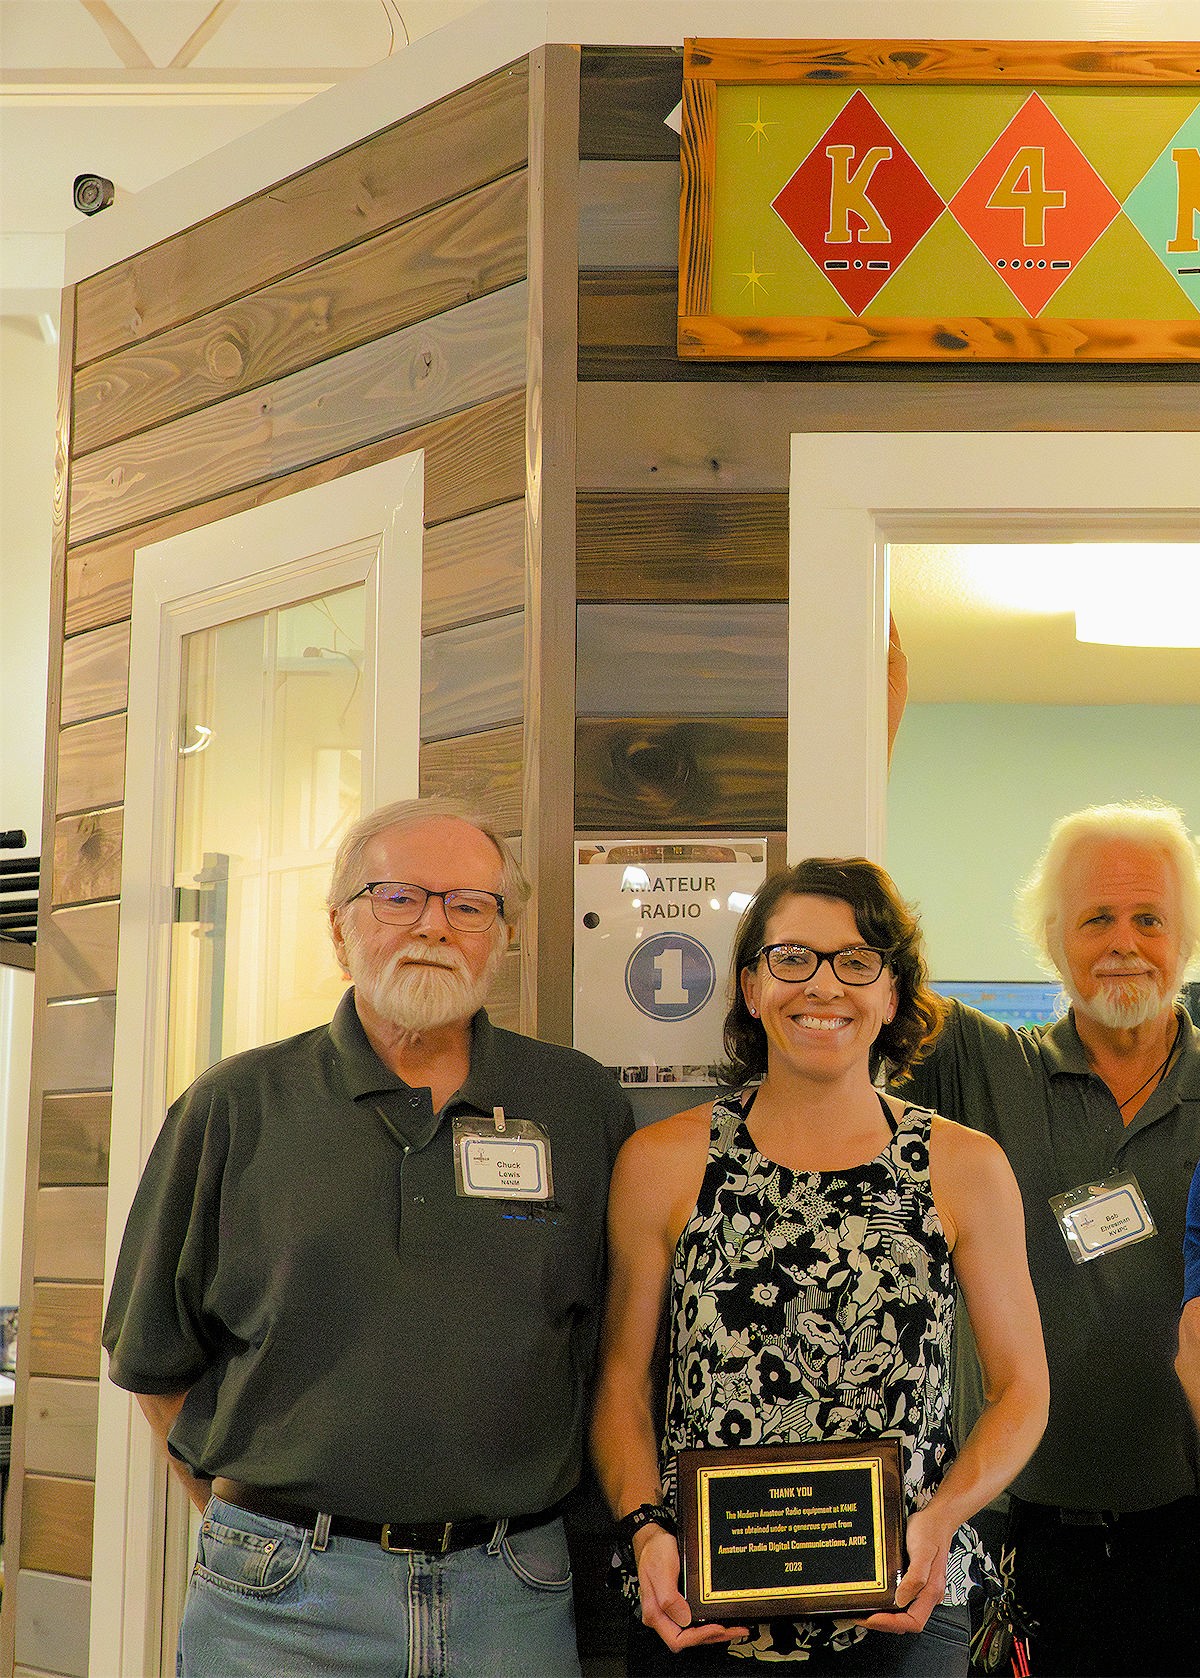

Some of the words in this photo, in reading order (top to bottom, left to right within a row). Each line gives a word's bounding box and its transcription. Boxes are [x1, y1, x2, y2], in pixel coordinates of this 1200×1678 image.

[620, 876, 717, 893] AATEUR
[641, 903, 701, 919] RADIO
[653, 948, 689, 1004] 1
[496, 1161, 521, 1169] Chuck
[498, 1170, 521, 1178] Lewis
[769, 1488, 796, 1499] THANK
[796, 1486, 813, 1497] YOU
[726, 1510, 737, 1520] The
[785, 1506, 802, 1516] Radio
[802, 1505, 832, 1517] equipment
[833, 1505, 840, 1513] at
[745, 1524, 769, 1534] obtained
[770, 1523, 787, 1533] under
[793, 1523, 820, 1533] generous
[821, 1521, 837, 1531] grant
[838, 1519, 852, 1529] from
[718, 1544, 747, 1554] Amateur
[748, 1542, 767, 1552] Radio
[769, 1541, 790, 1552] Digital
[791, 1538, 848, 1550] Communications,
[848, 1535, 867, 1546] ARDC
[785, 1561, 803, 1572] 2023
